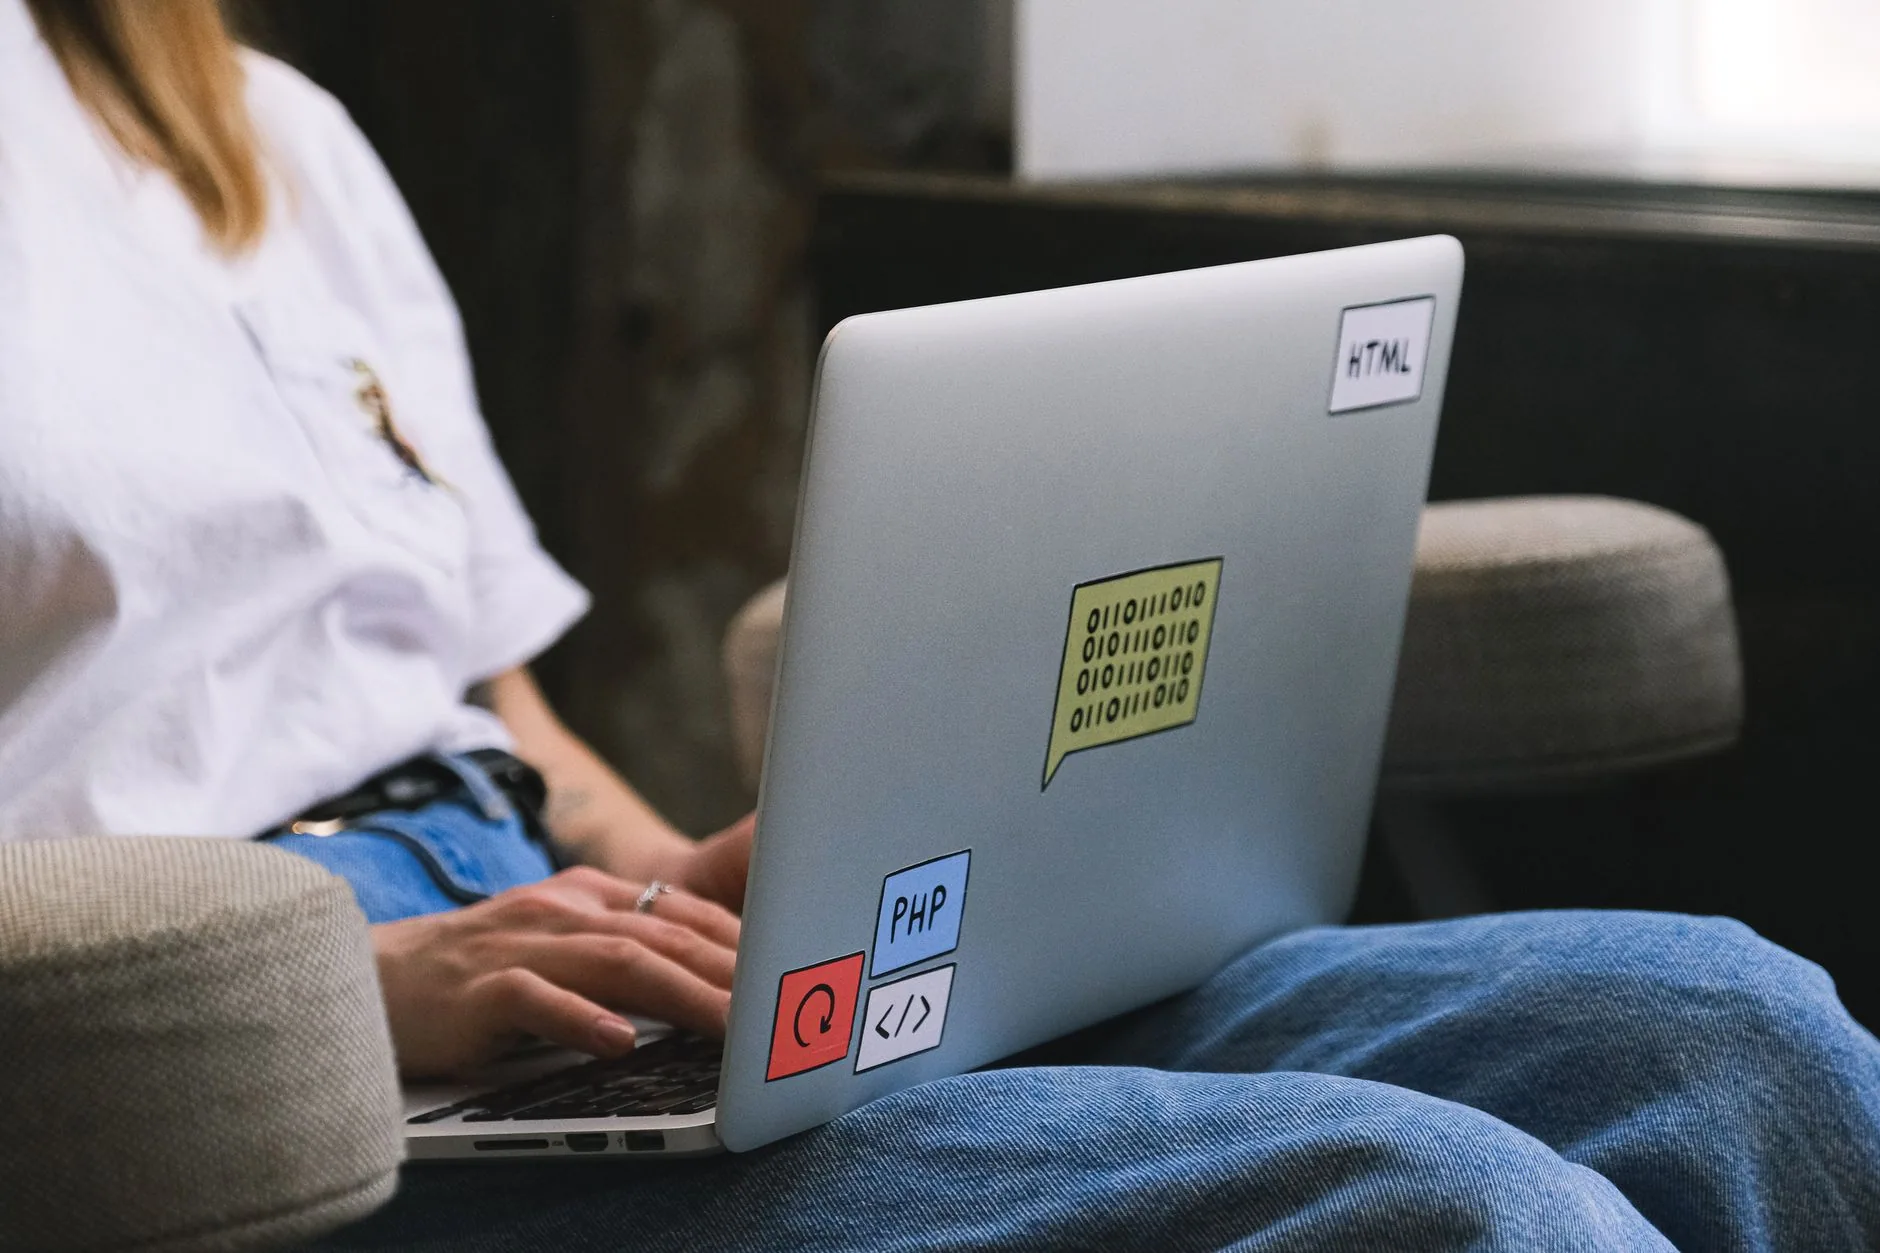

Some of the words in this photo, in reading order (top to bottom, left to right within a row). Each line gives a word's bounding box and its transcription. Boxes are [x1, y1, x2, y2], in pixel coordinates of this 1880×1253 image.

[1347, 338, 1410, 379] HTML
[1087, 580, 1206, 634] 0110111010
[1082, 618, 1200, 663] 0101110110
[1076, 650, 1194, 696] 0101110110
[1070, 677, 1190, 733] 0110111010
[890, 884, 947, 944] PHP
